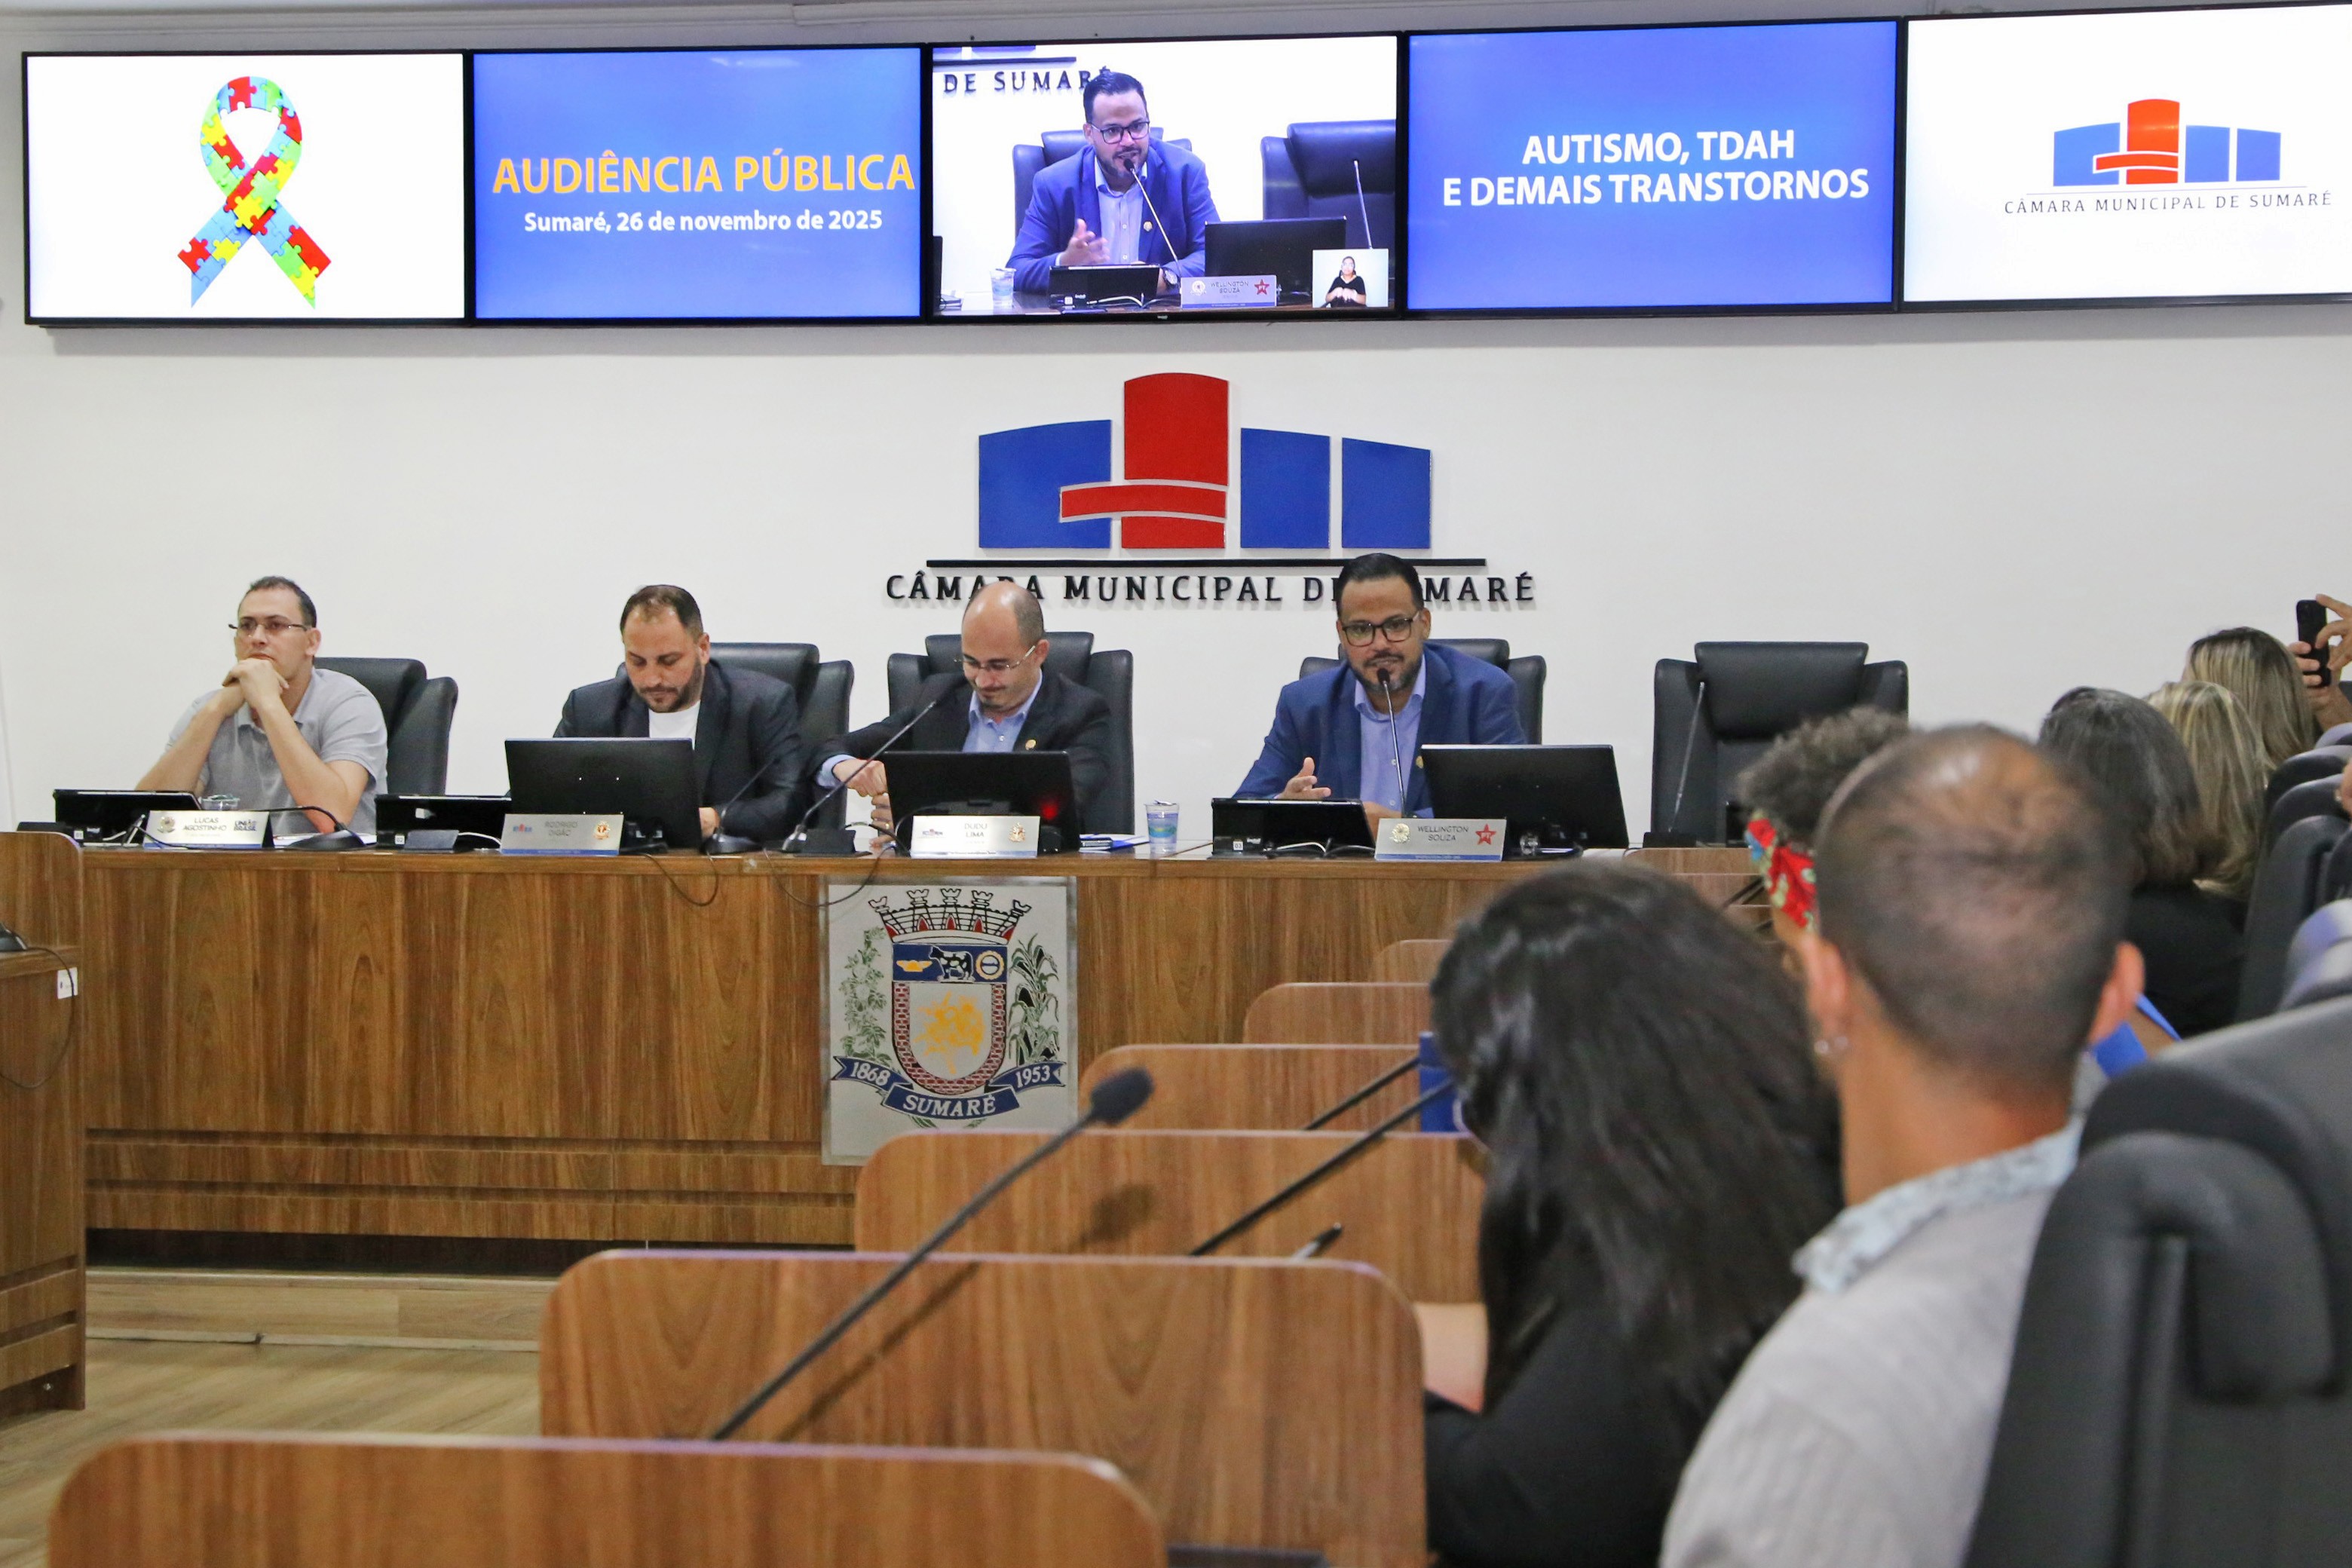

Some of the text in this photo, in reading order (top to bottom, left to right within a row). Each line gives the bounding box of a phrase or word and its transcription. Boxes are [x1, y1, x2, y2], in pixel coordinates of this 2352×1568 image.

[944, 73, 976, 93] DE
[1522, 130, 1795, 165] AUTISMO, TDAH
[492, 148, 917, 194] AUDIÊNCIA PÚBLICA
[1443, 168, 1870, 207] E DEMAIS TRANSTORNOS
[2004, 190, 2332, 214] CÂMARA MUNICIPAL DE SUMARÉ
[524, 209, 883, 234] Sumaré, 26 de novembro de 2025
[1063, 575, 1283, 602] MUNICIPAL
[851, 1061, 890, 1086] 1868
[1016, 1064, 1051, 1086] 1953
[904, 1094, 996, 1117] SUMARÉ
